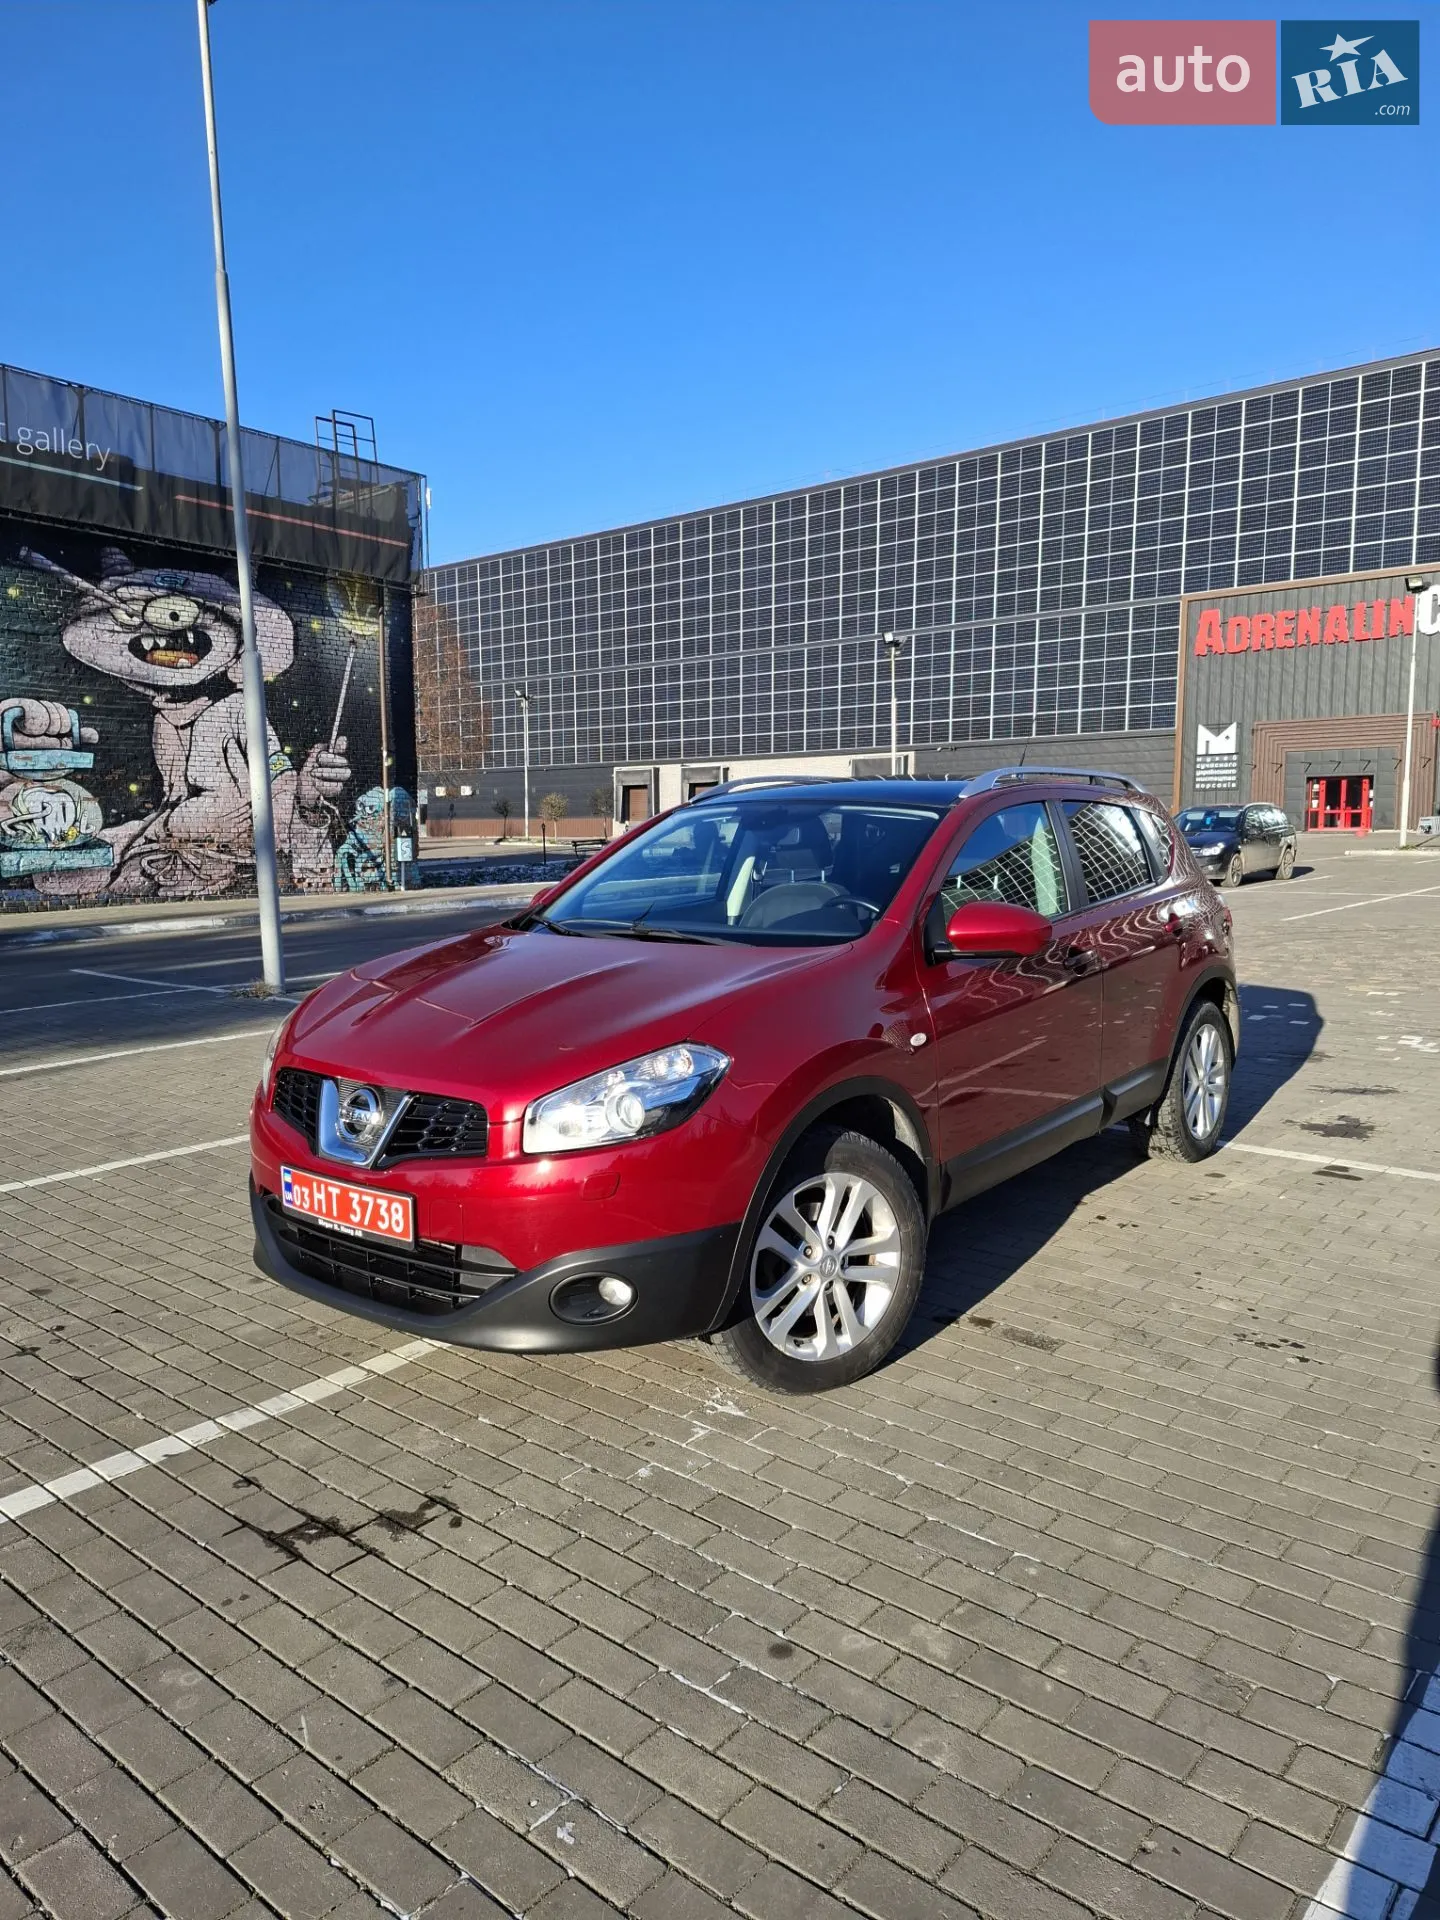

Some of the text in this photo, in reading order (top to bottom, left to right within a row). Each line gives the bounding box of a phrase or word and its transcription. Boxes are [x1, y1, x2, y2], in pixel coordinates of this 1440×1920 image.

[16, 426, 111, 471] gallery
[1194, 596, 1415, 657] ADRENALIN
[348, 1192, 404, 1233] 3738
